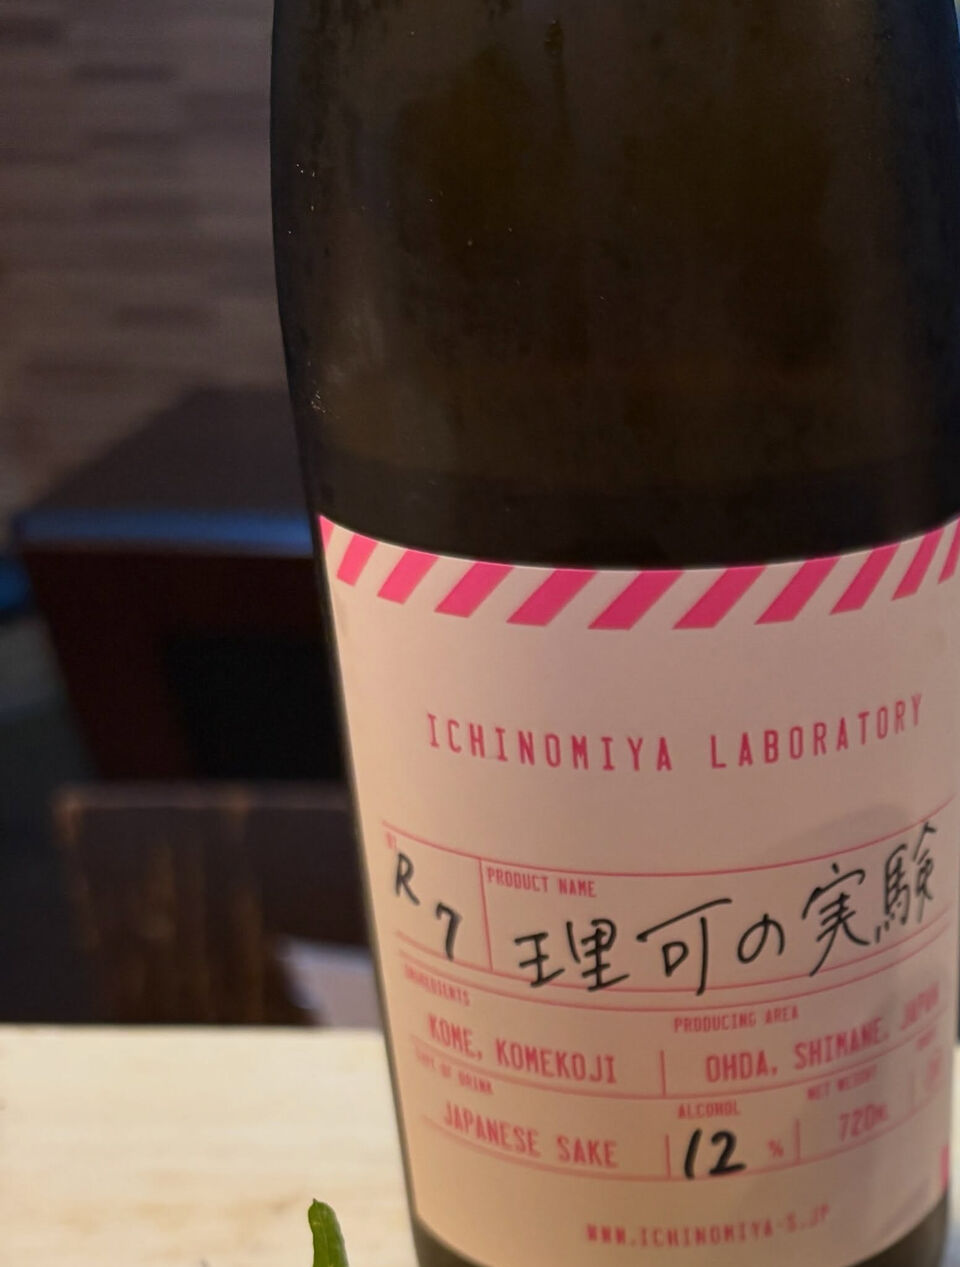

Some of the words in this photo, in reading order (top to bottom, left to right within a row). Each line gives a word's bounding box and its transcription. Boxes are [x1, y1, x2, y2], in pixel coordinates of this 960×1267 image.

[426, 712, 673, 772] ICHINOMIYA
[709, 693, 923, 769] LABORATORY
[395, 852, 420, 905] R
[436, 902, 462, 961] 7
[486, 866, 549, 892] PRODUCT
[558, 878, 597, 898] NAME
[514, 821, 937, 995] 理可の実験
[428, 1013, 482, 1061] KOME,
[495, 1039, 616, 1084] KOMEKOJI
[674, 1011, 756, 1033] PRODUCING
[765, 1005, 799, 1023] AREA
[445, 1101, 541, 1158] JAPANESE
[556, 1134, 617, 1168] SAKE
[677, 1100, 740, 1119] ALCOHOL
[684, 1129, 746, 1180] 12
